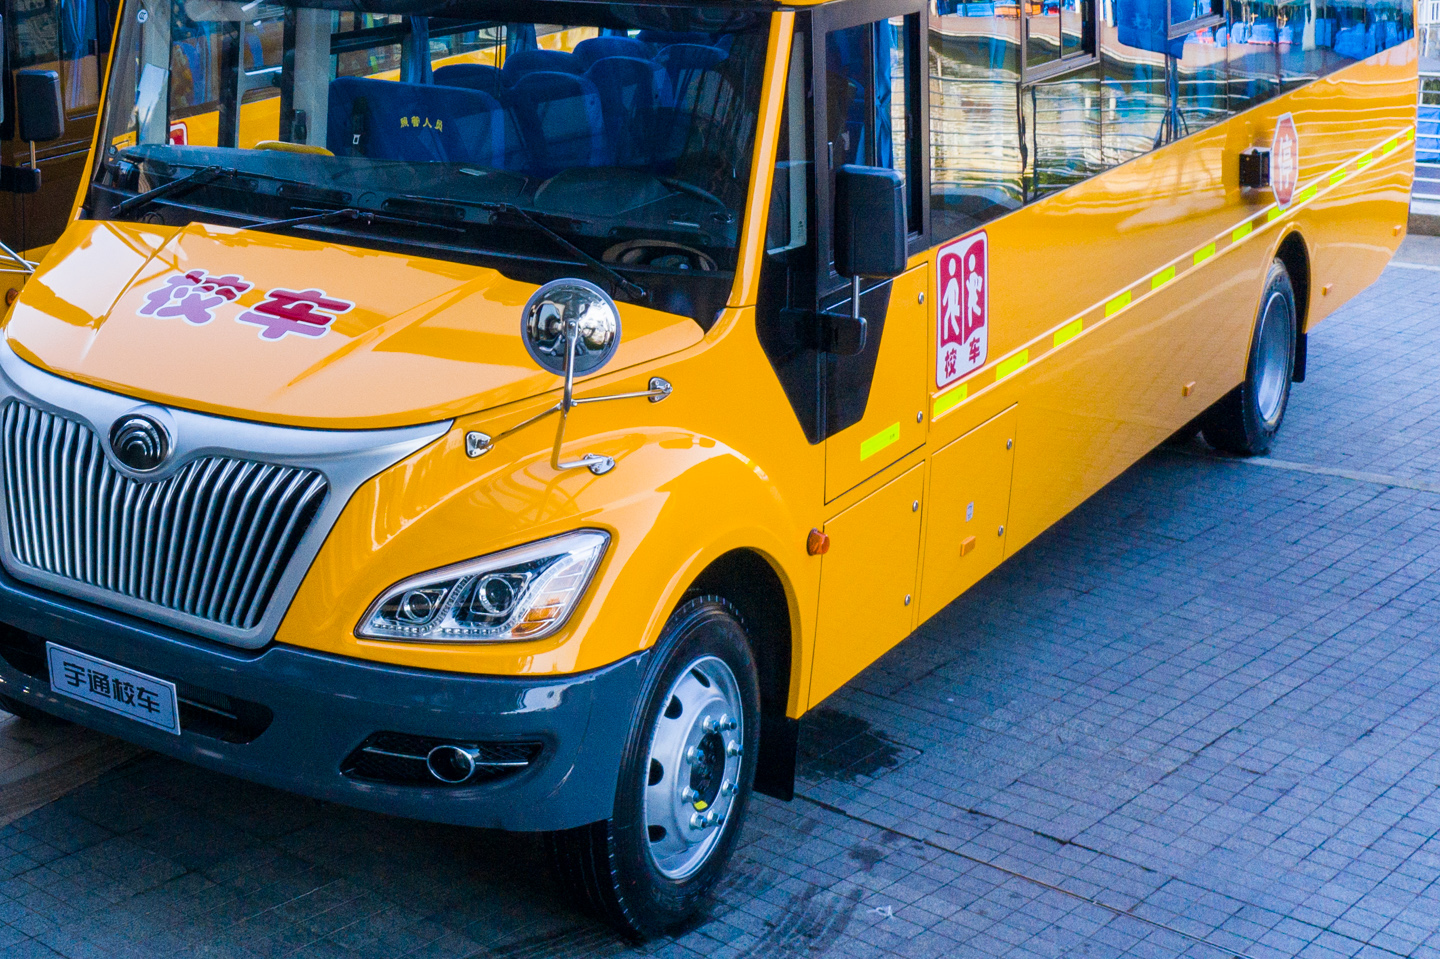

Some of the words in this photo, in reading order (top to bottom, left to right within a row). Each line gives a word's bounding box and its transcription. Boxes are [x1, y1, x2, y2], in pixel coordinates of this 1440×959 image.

[137, 269, 356, 342] 校车
[944, 336, 981, 379] 校车
[63, 661, 160, 714] 宇通校车
